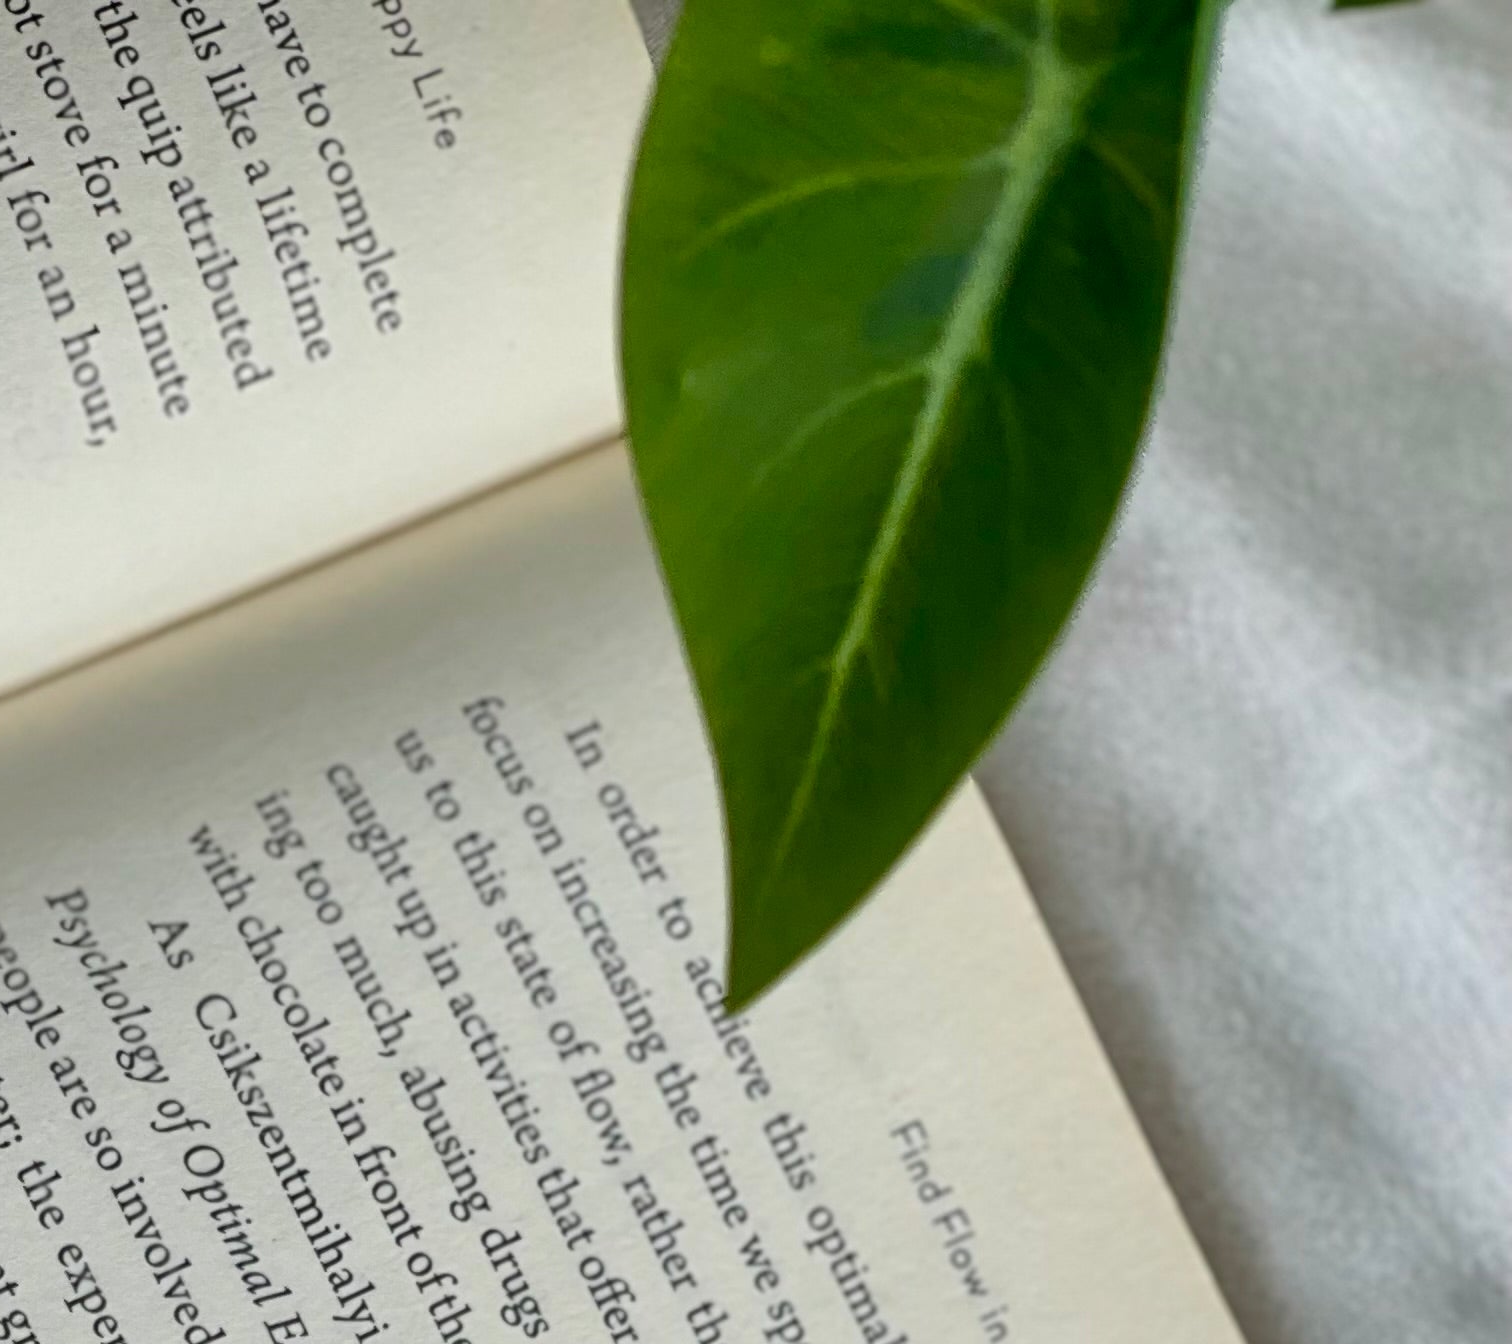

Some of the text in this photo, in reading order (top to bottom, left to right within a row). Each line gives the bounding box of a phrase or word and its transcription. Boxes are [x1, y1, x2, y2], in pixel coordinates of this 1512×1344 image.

[411, 67, 464, 150] Life
[93, 0, 275, 392] the quip attributed
[6, 189, 54, 252] for
[37, 265, 76, 323] an
[60, 323, 118, 448] hour,
[394, 728, 436, 775] us
[424, 779, 462, 823] to
[452, 830, 508, 908] this
[494, 916, 558, 1009] state
[44, 887, 293, 1308] Psychology of Optimal
[188, 823, 257, 913] with
[236, 914, 345, 1097] chocolate
[329, 1096, 367, 1146] in
[353, 1144, 424, 1248] front
[406, 1250, 459, 1295] of
[254, 789, 307, 860] ing
[293, 858, 344, 926] too
[332, 934, 413, 1059] much,
[399, 1066, 492, 1223] abusing
[479, 1227, 550, 1339] drugs
[547, 1019, 601, 1063] of
[48, 1055, 98, 1121] are
[83, 1125, 124, 1172] so
[147, 921, 195, 971] As
[194, 992, 390, 1344] Csikszentmihalyi
[570, 1068, 633, 1167] flow,
[16, 1159, 65, 1230] the
[621, 1173, 699, 1292] rather
[889, 1117, 954, 1206] Find
[931, 1206, 990, 1298] Flow
[978, 1304, 1009, 1344] in
